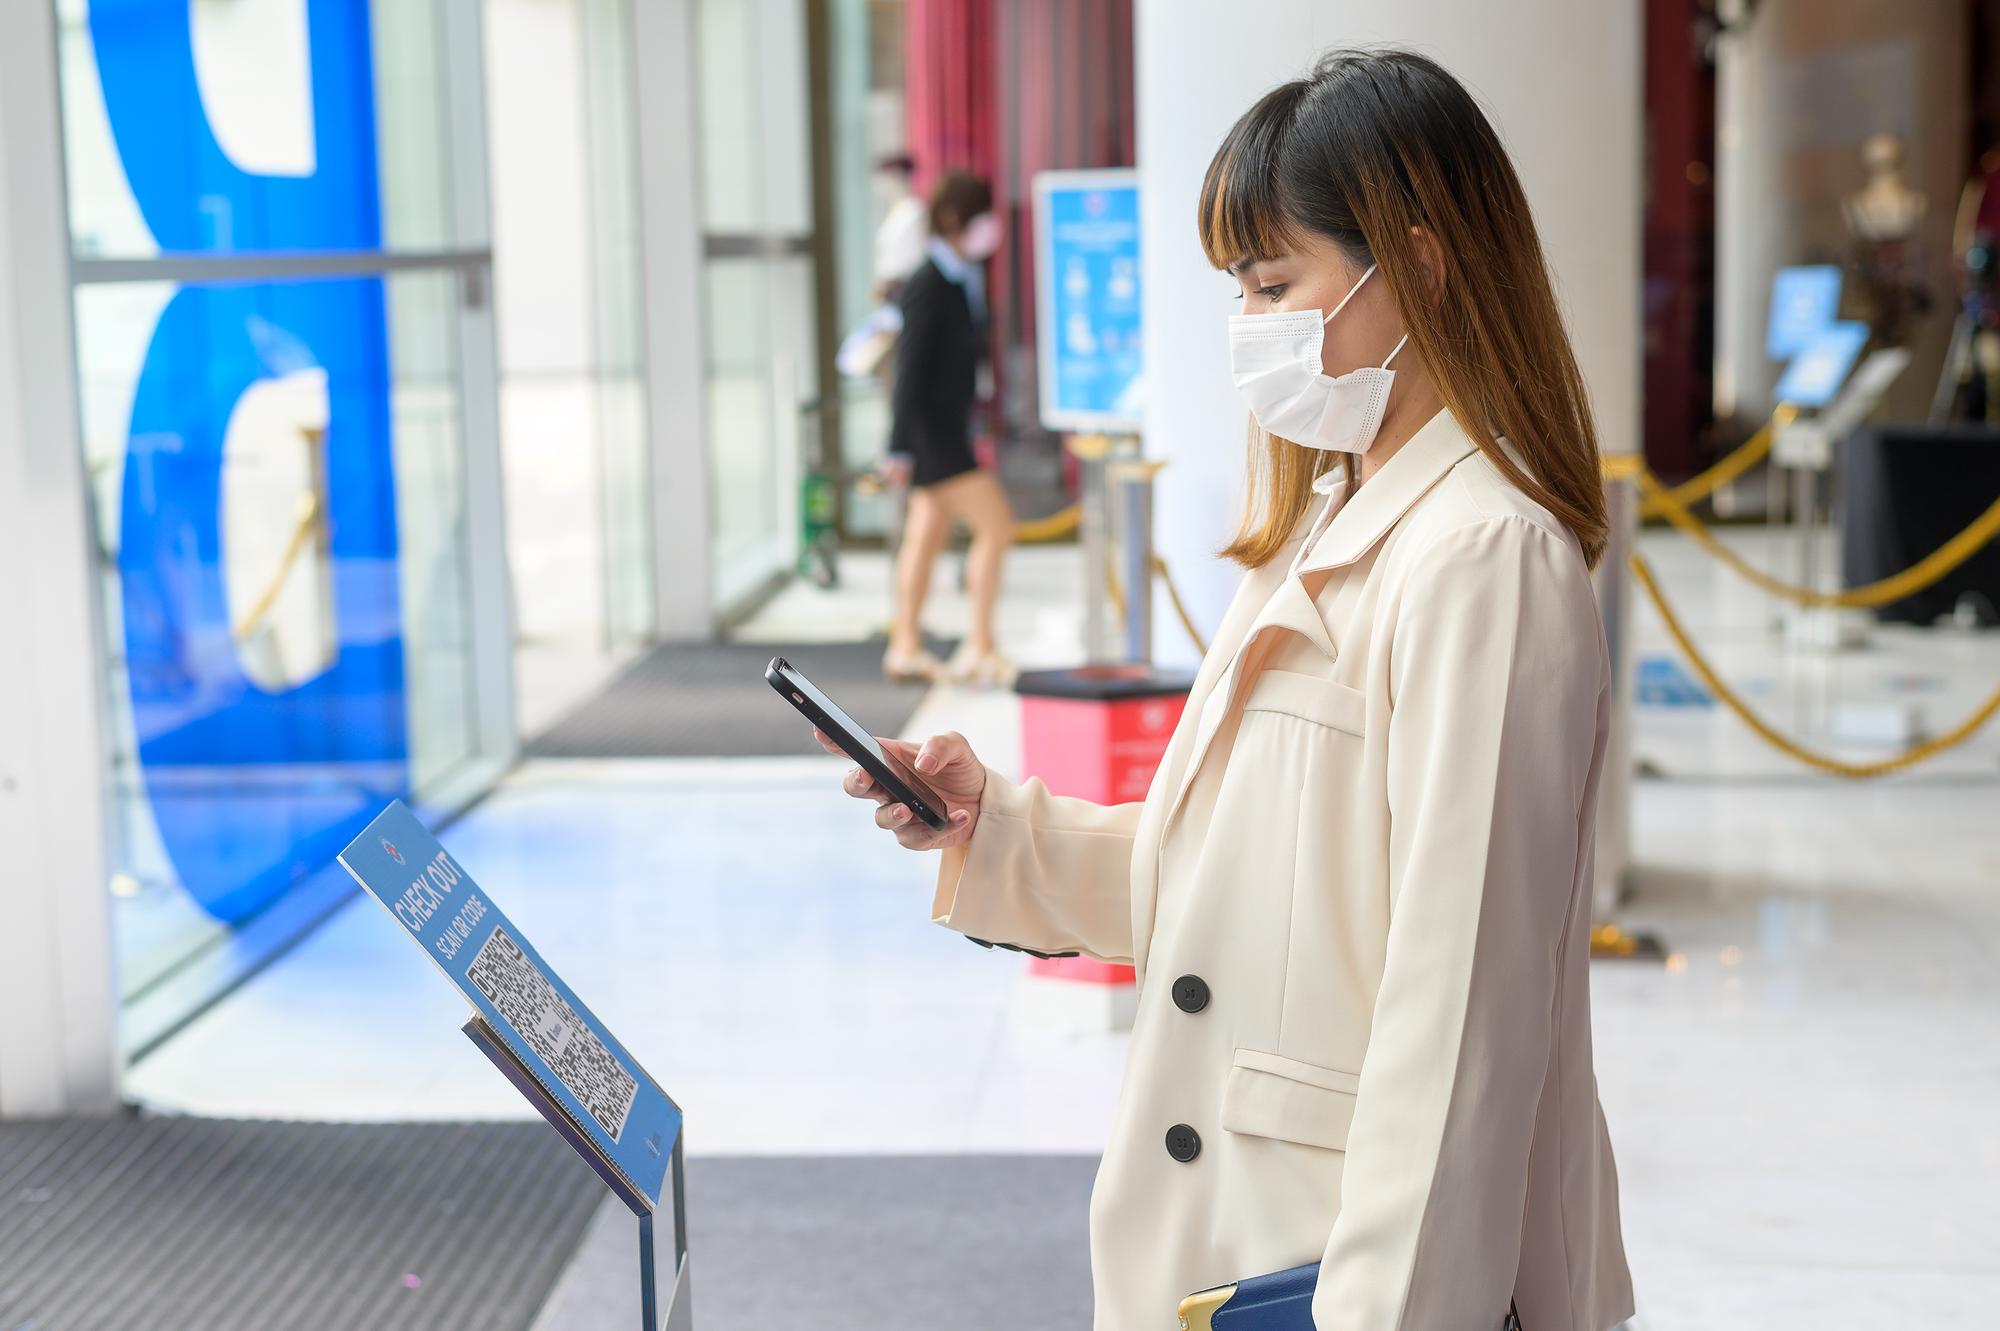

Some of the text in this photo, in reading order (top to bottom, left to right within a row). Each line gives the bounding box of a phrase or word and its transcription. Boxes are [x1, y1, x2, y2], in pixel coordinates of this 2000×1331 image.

[394, 850, 463, 932] CHECK OUT
[435, 893, 488, 961] SCAN QR CODE
